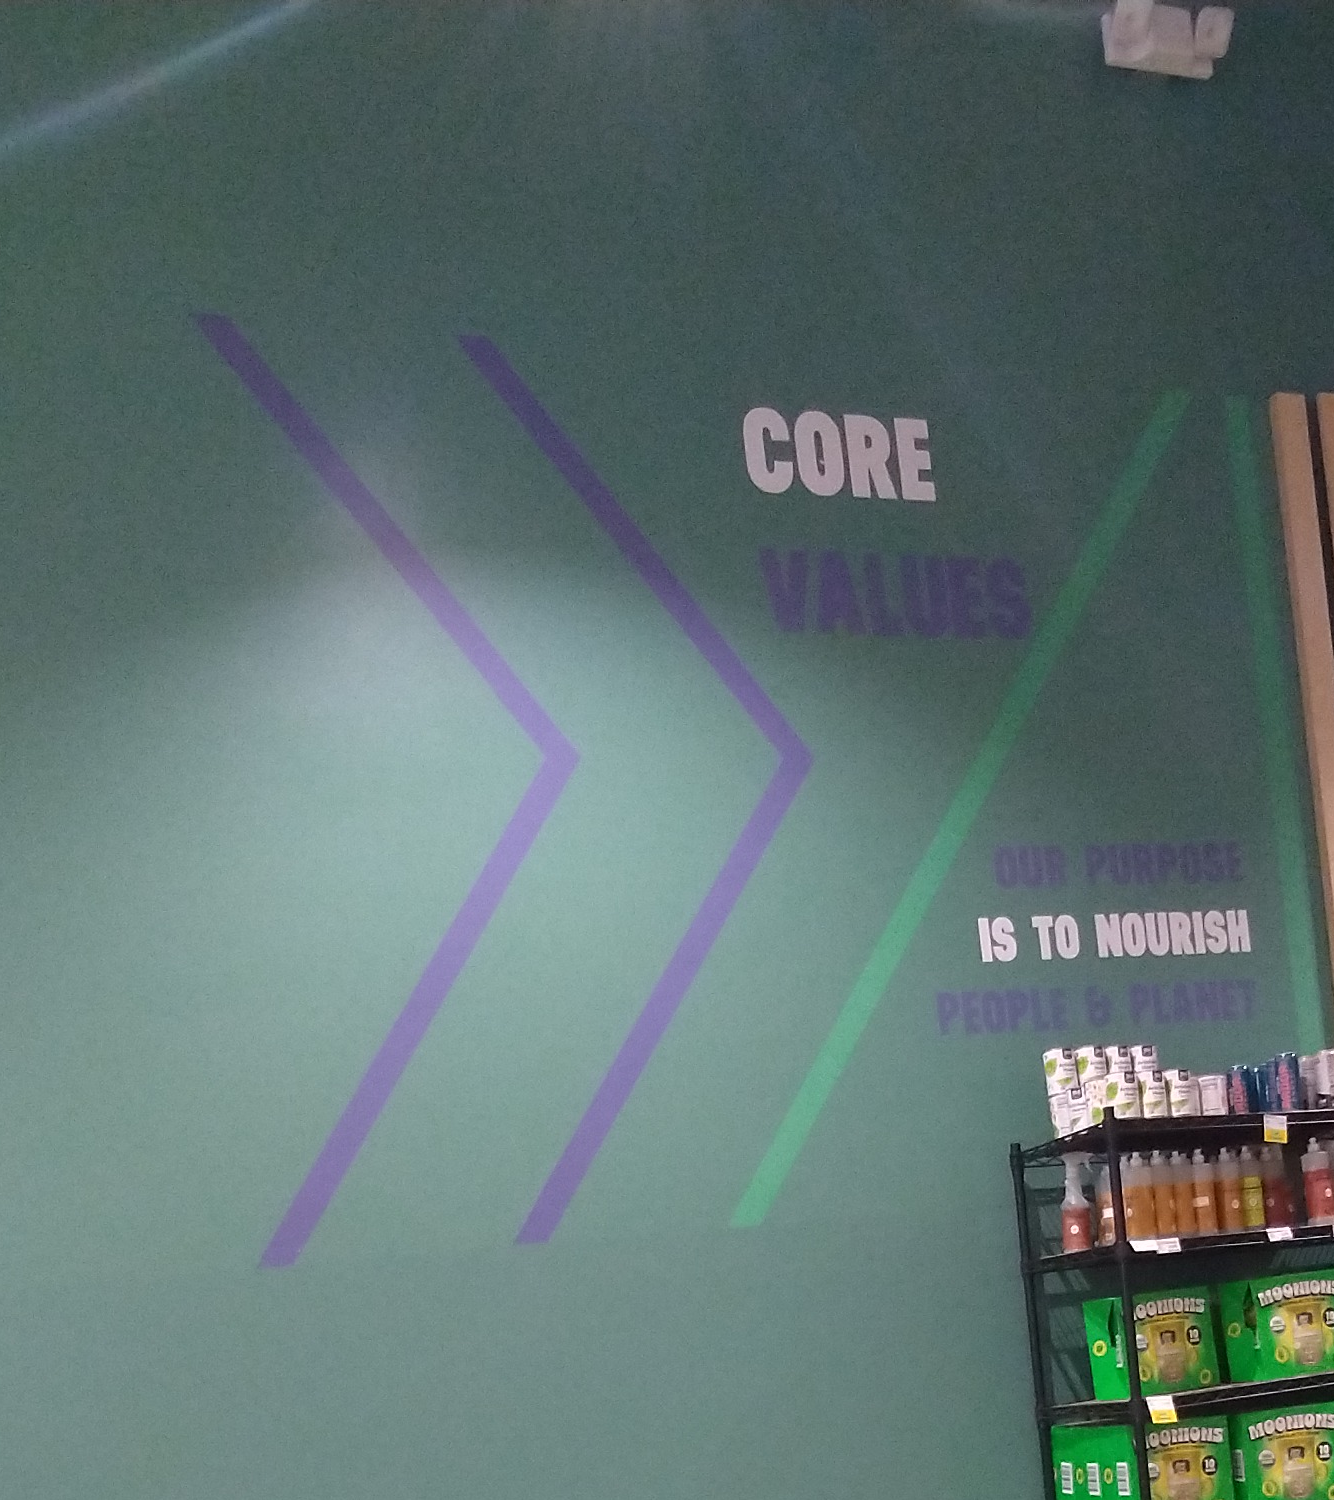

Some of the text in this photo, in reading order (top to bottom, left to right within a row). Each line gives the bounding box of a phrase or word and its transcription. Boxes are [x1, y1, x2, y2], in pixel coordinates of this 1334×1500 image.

[742, 406, 937, 502] CORE
[758, 545, 1033, 641] VALUES
[992, 838, 1245, 890] OUR PURPOSE
[977, 909, 1252, 963] IS TO NOURISH
[936, 987, 1067, 1037] PEOPLE
[1127, 978, 1258, 1025] PLANET
